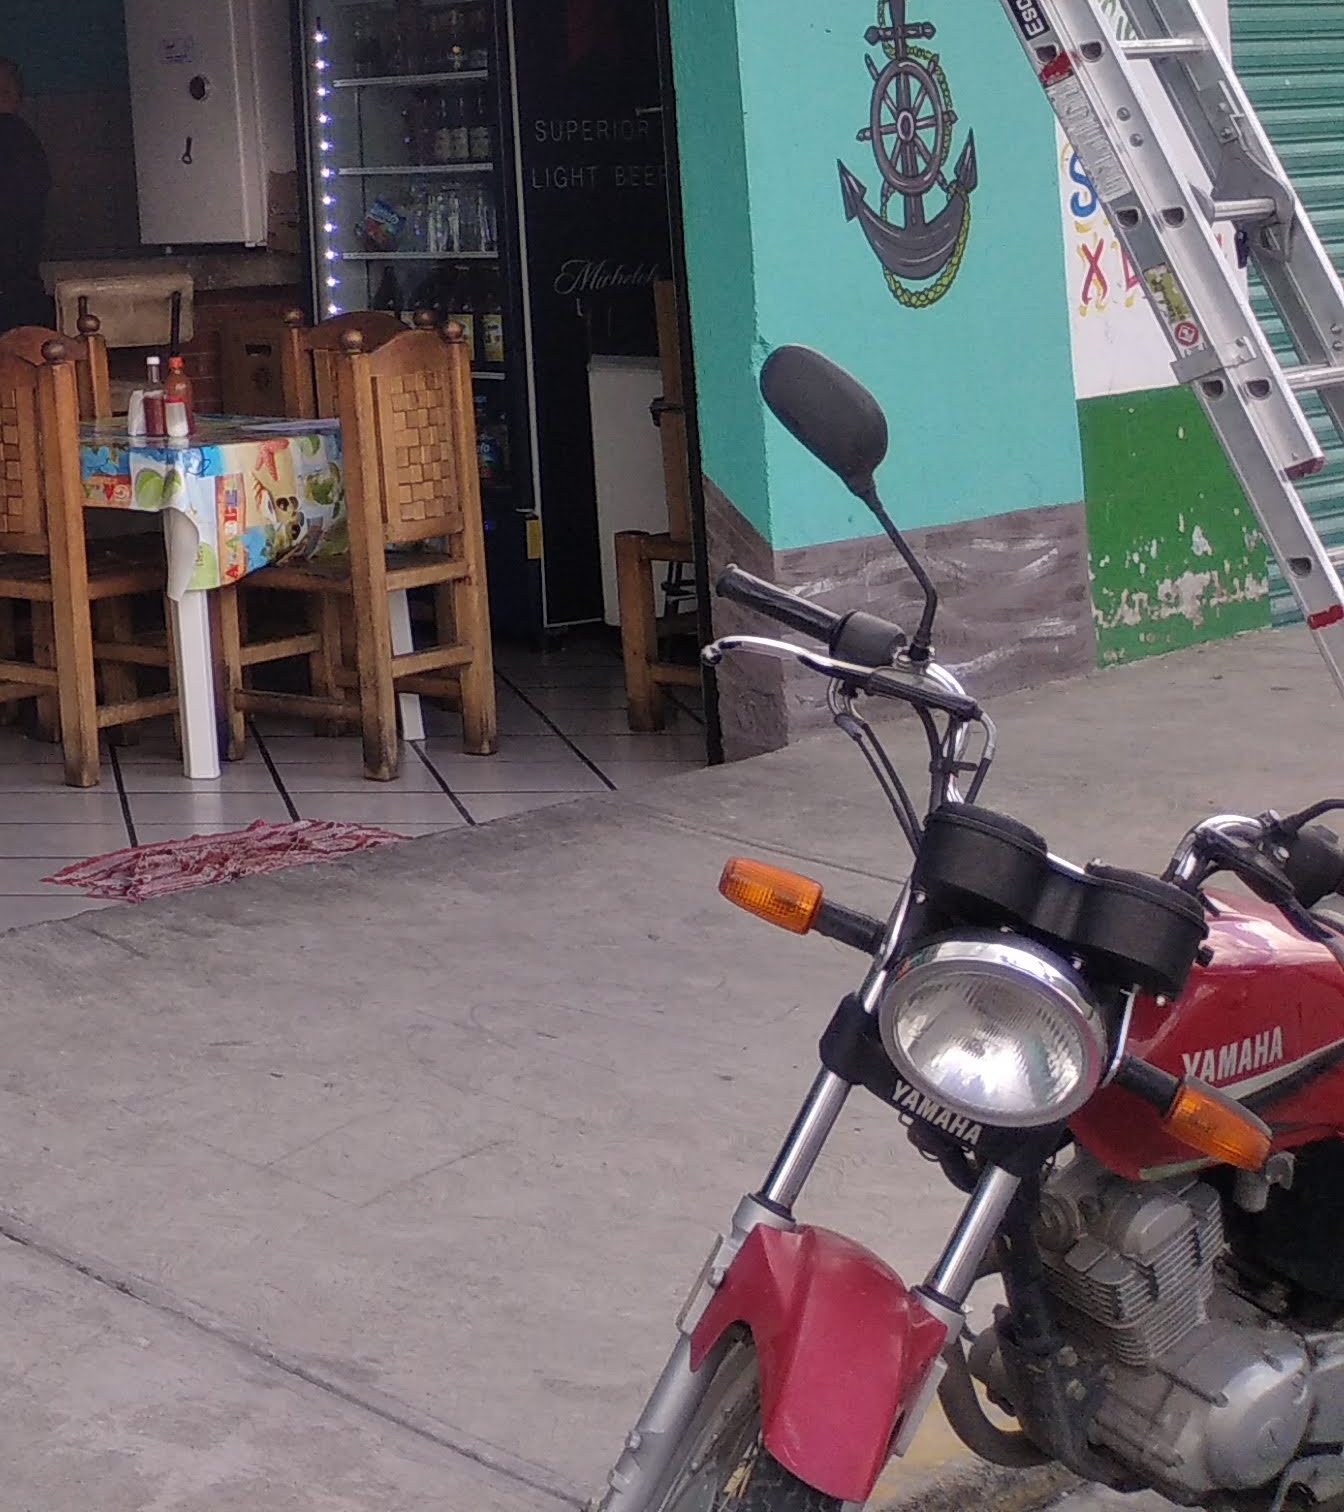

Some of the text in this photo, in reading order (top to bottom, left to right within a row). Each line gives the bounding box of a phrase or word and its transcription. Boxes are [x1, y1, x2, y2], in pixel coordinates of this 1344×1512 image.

[533, 118, 651, 144] SUPERIOR
[530, 165, 601, 190] LIGHT
[1181, 1024, 1284, 1083] YAMAHA
[890, 1078, 984, 1147] YAMAHA
